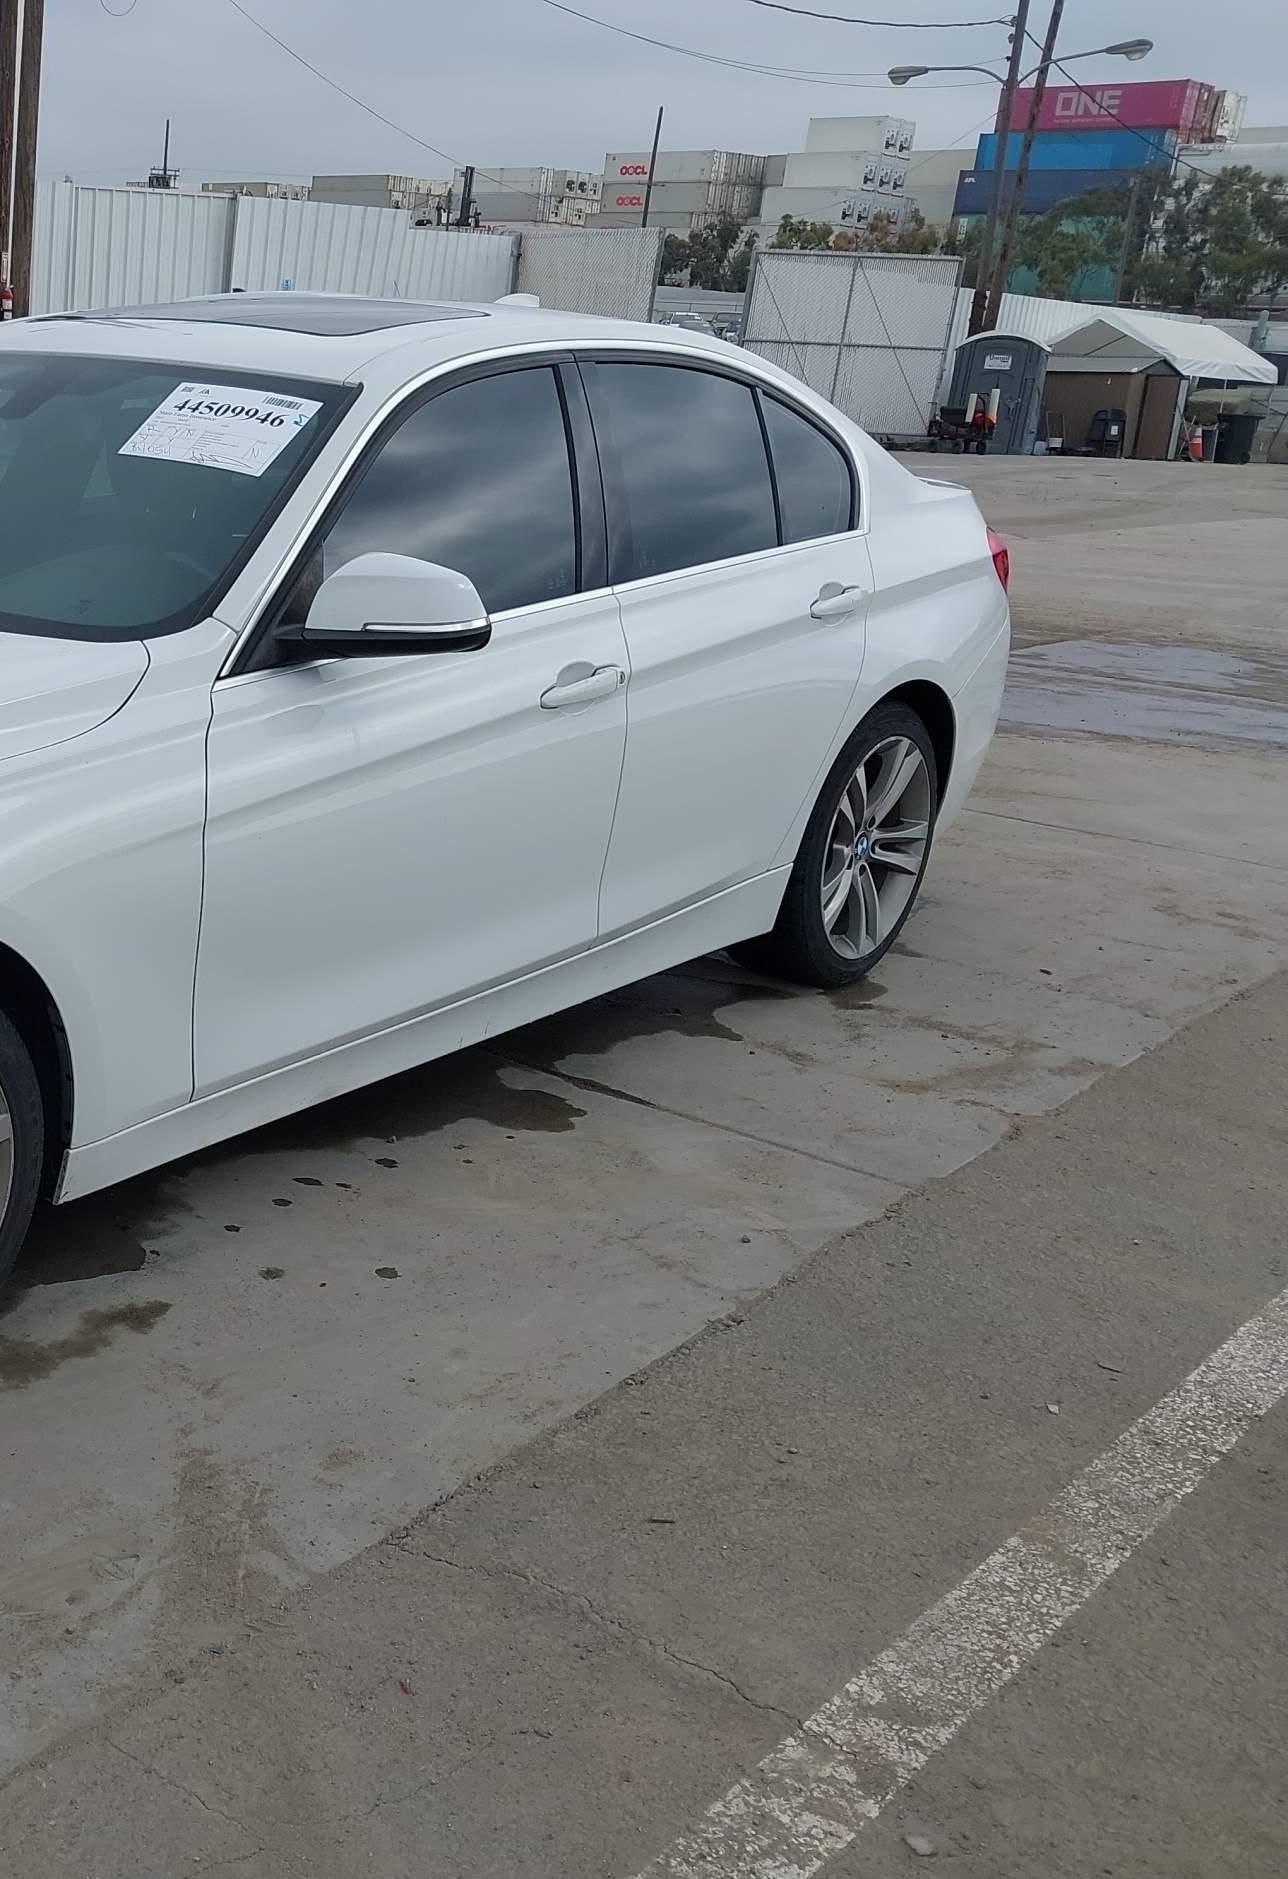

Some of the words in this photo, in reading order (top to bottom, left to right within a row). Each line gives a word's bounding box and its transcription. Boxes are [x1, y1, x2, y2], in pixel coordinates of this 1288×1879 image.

[1055, 90, 1123, 116] ONE
[620, 165, 648, 176] OOCL
[616, 196, 643, 206] OOCL
[173, 398, 289, 428] 44509946
